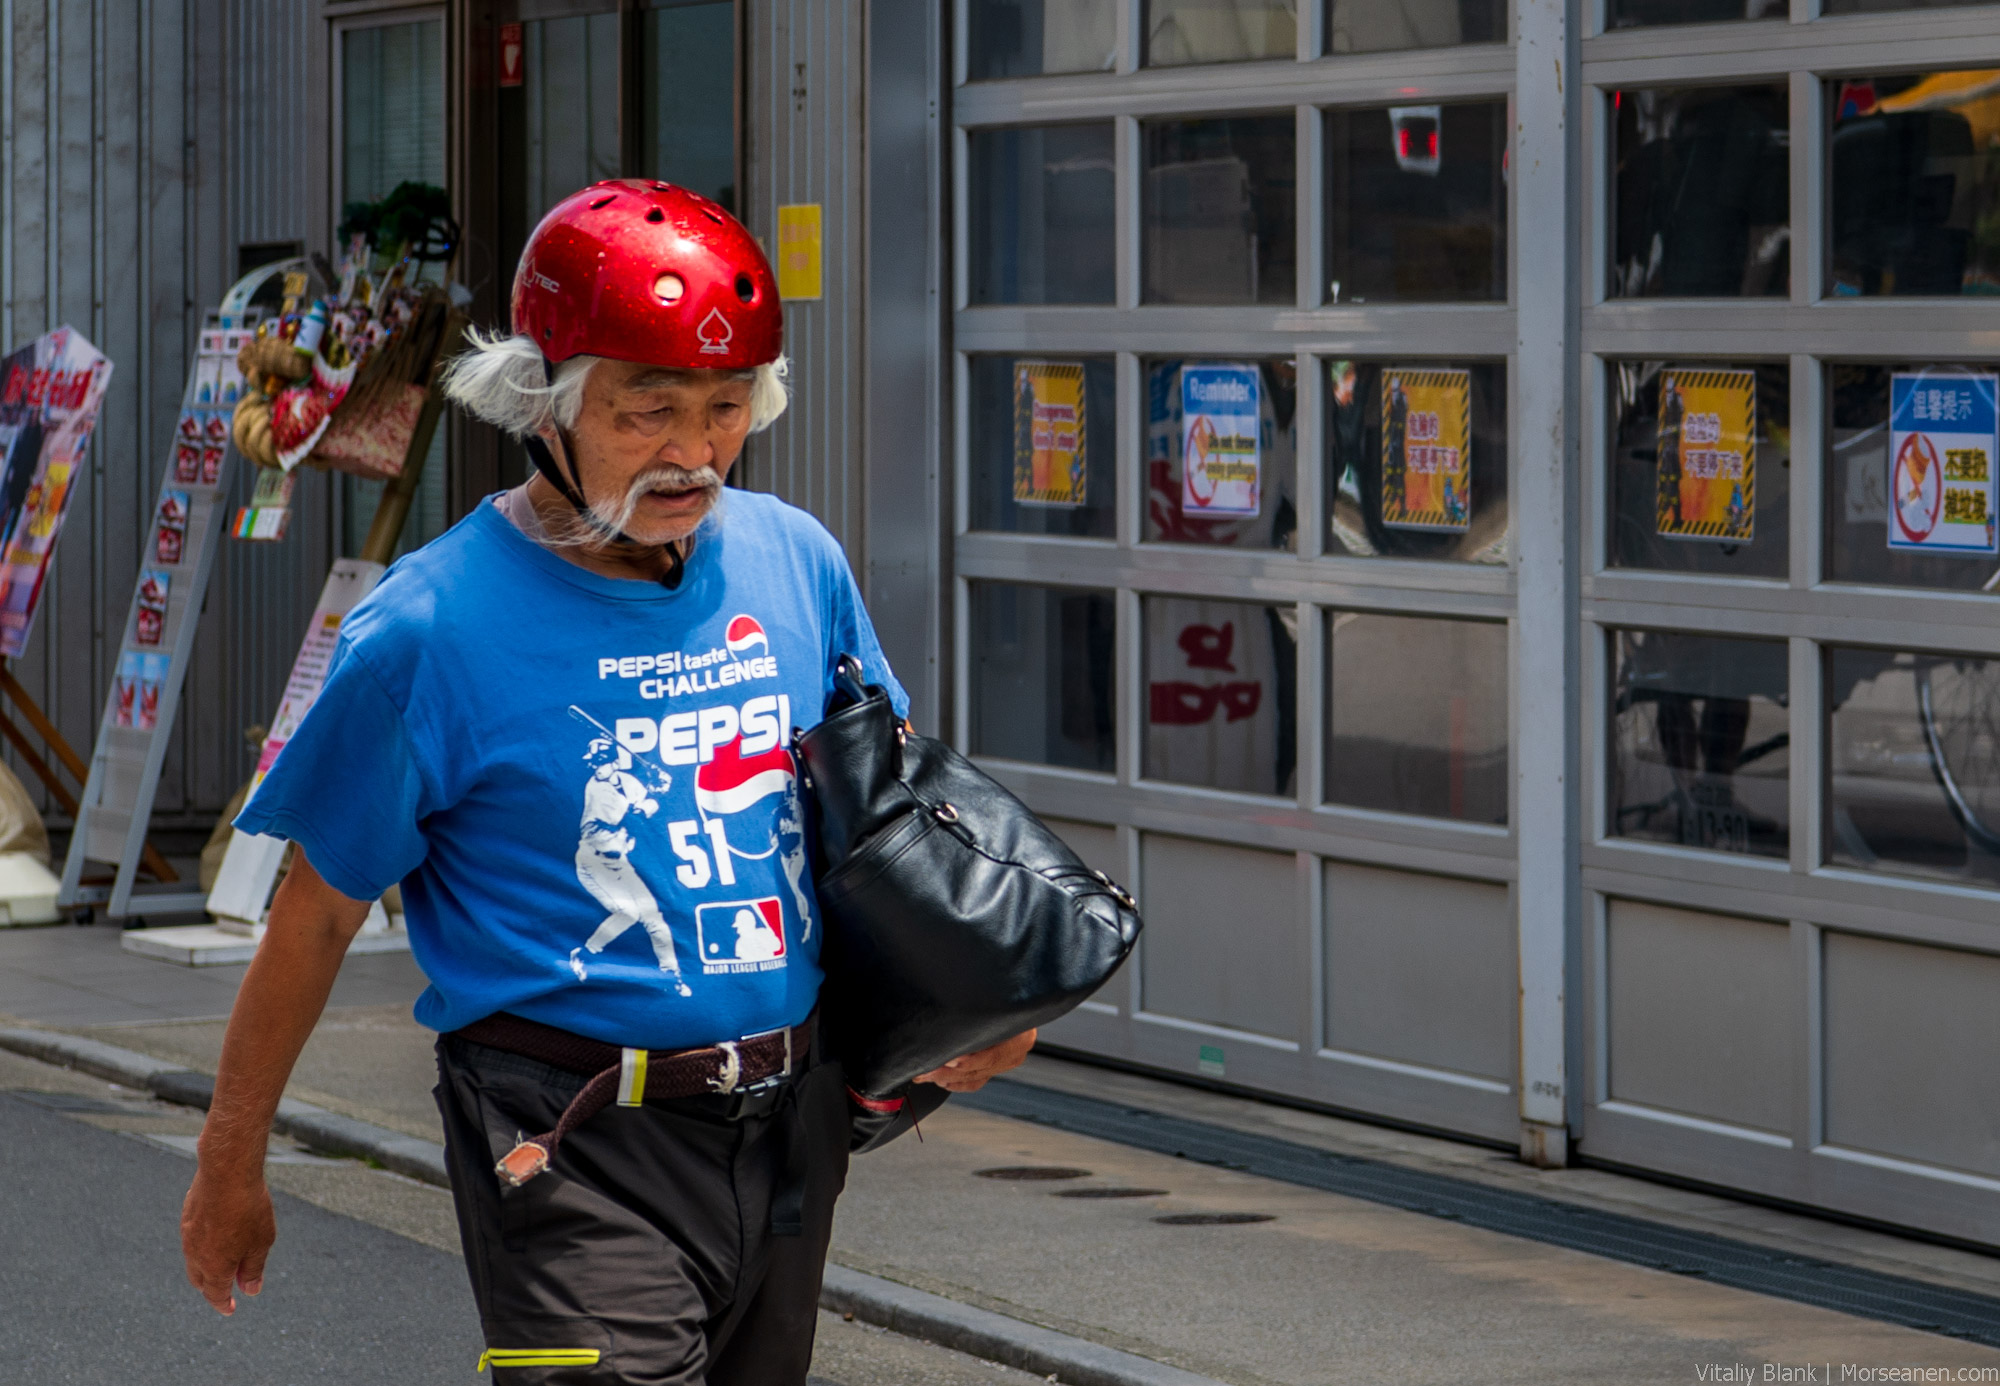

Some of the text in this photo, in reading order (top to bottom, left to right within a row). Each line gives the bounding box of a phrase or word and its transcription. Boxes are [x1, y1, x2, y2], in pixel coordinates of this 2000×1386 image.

[1190, 377, 1250, 402] Reminder
[598, 647, 728, 680] PEPSI taste
[639, 656, 778, 700] CHALLENGE
[615, 694, 792, 769] PEPSI
[667, 818, 736, 889] 51
[703, 958, 787, 975] MAJOR LEAGUE BASEBALL
